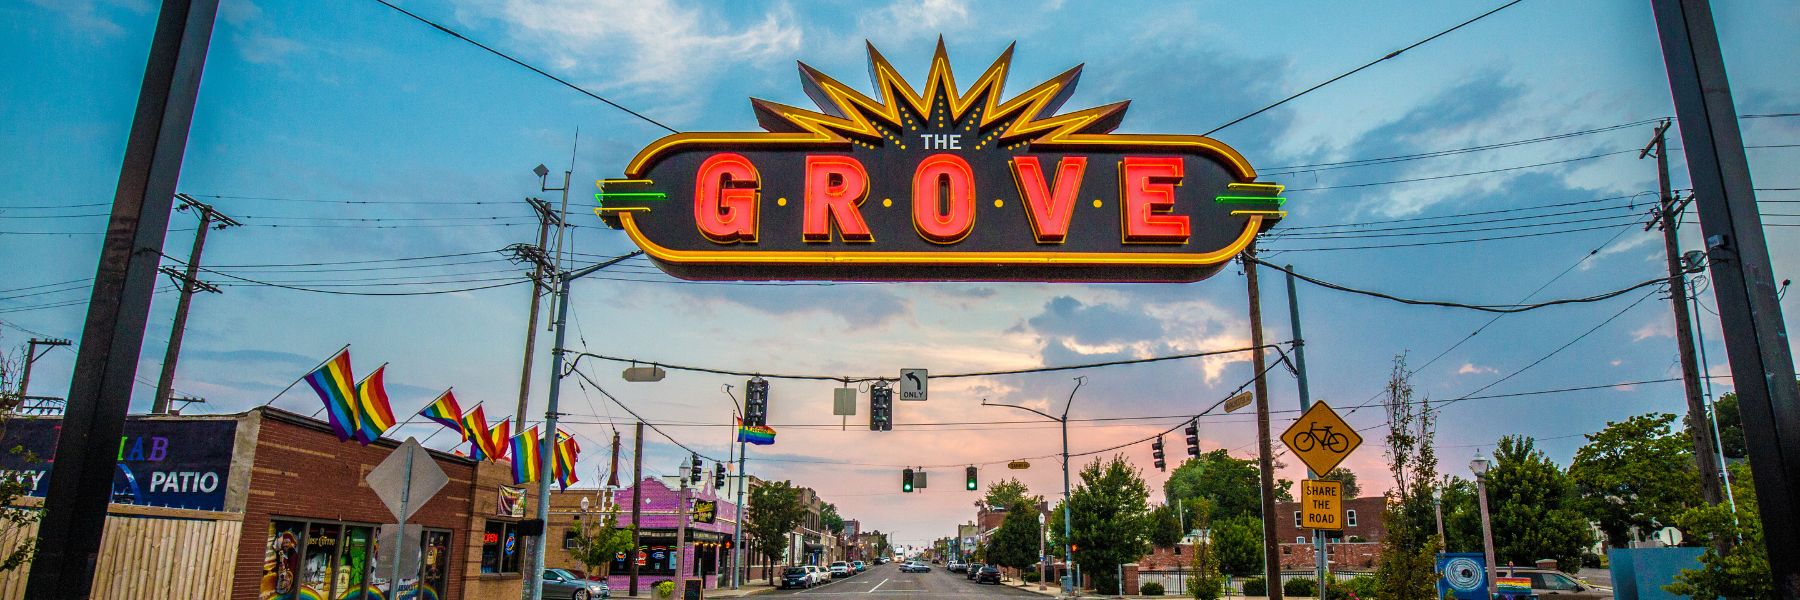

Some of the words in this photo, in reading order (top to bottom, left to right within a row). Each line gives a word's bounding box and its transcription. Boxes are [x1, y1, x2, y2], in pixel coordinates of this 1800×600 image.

[920, 133, 962, 150] THE
[903, 391, 924, 399] ONLY
[149, 471, 219, 493] PATIO
[1306, 485, 1337, 497] SHARE
[1312, 499, 1330, 510] THE
[1309, 513, 1335, 524] ROAD
